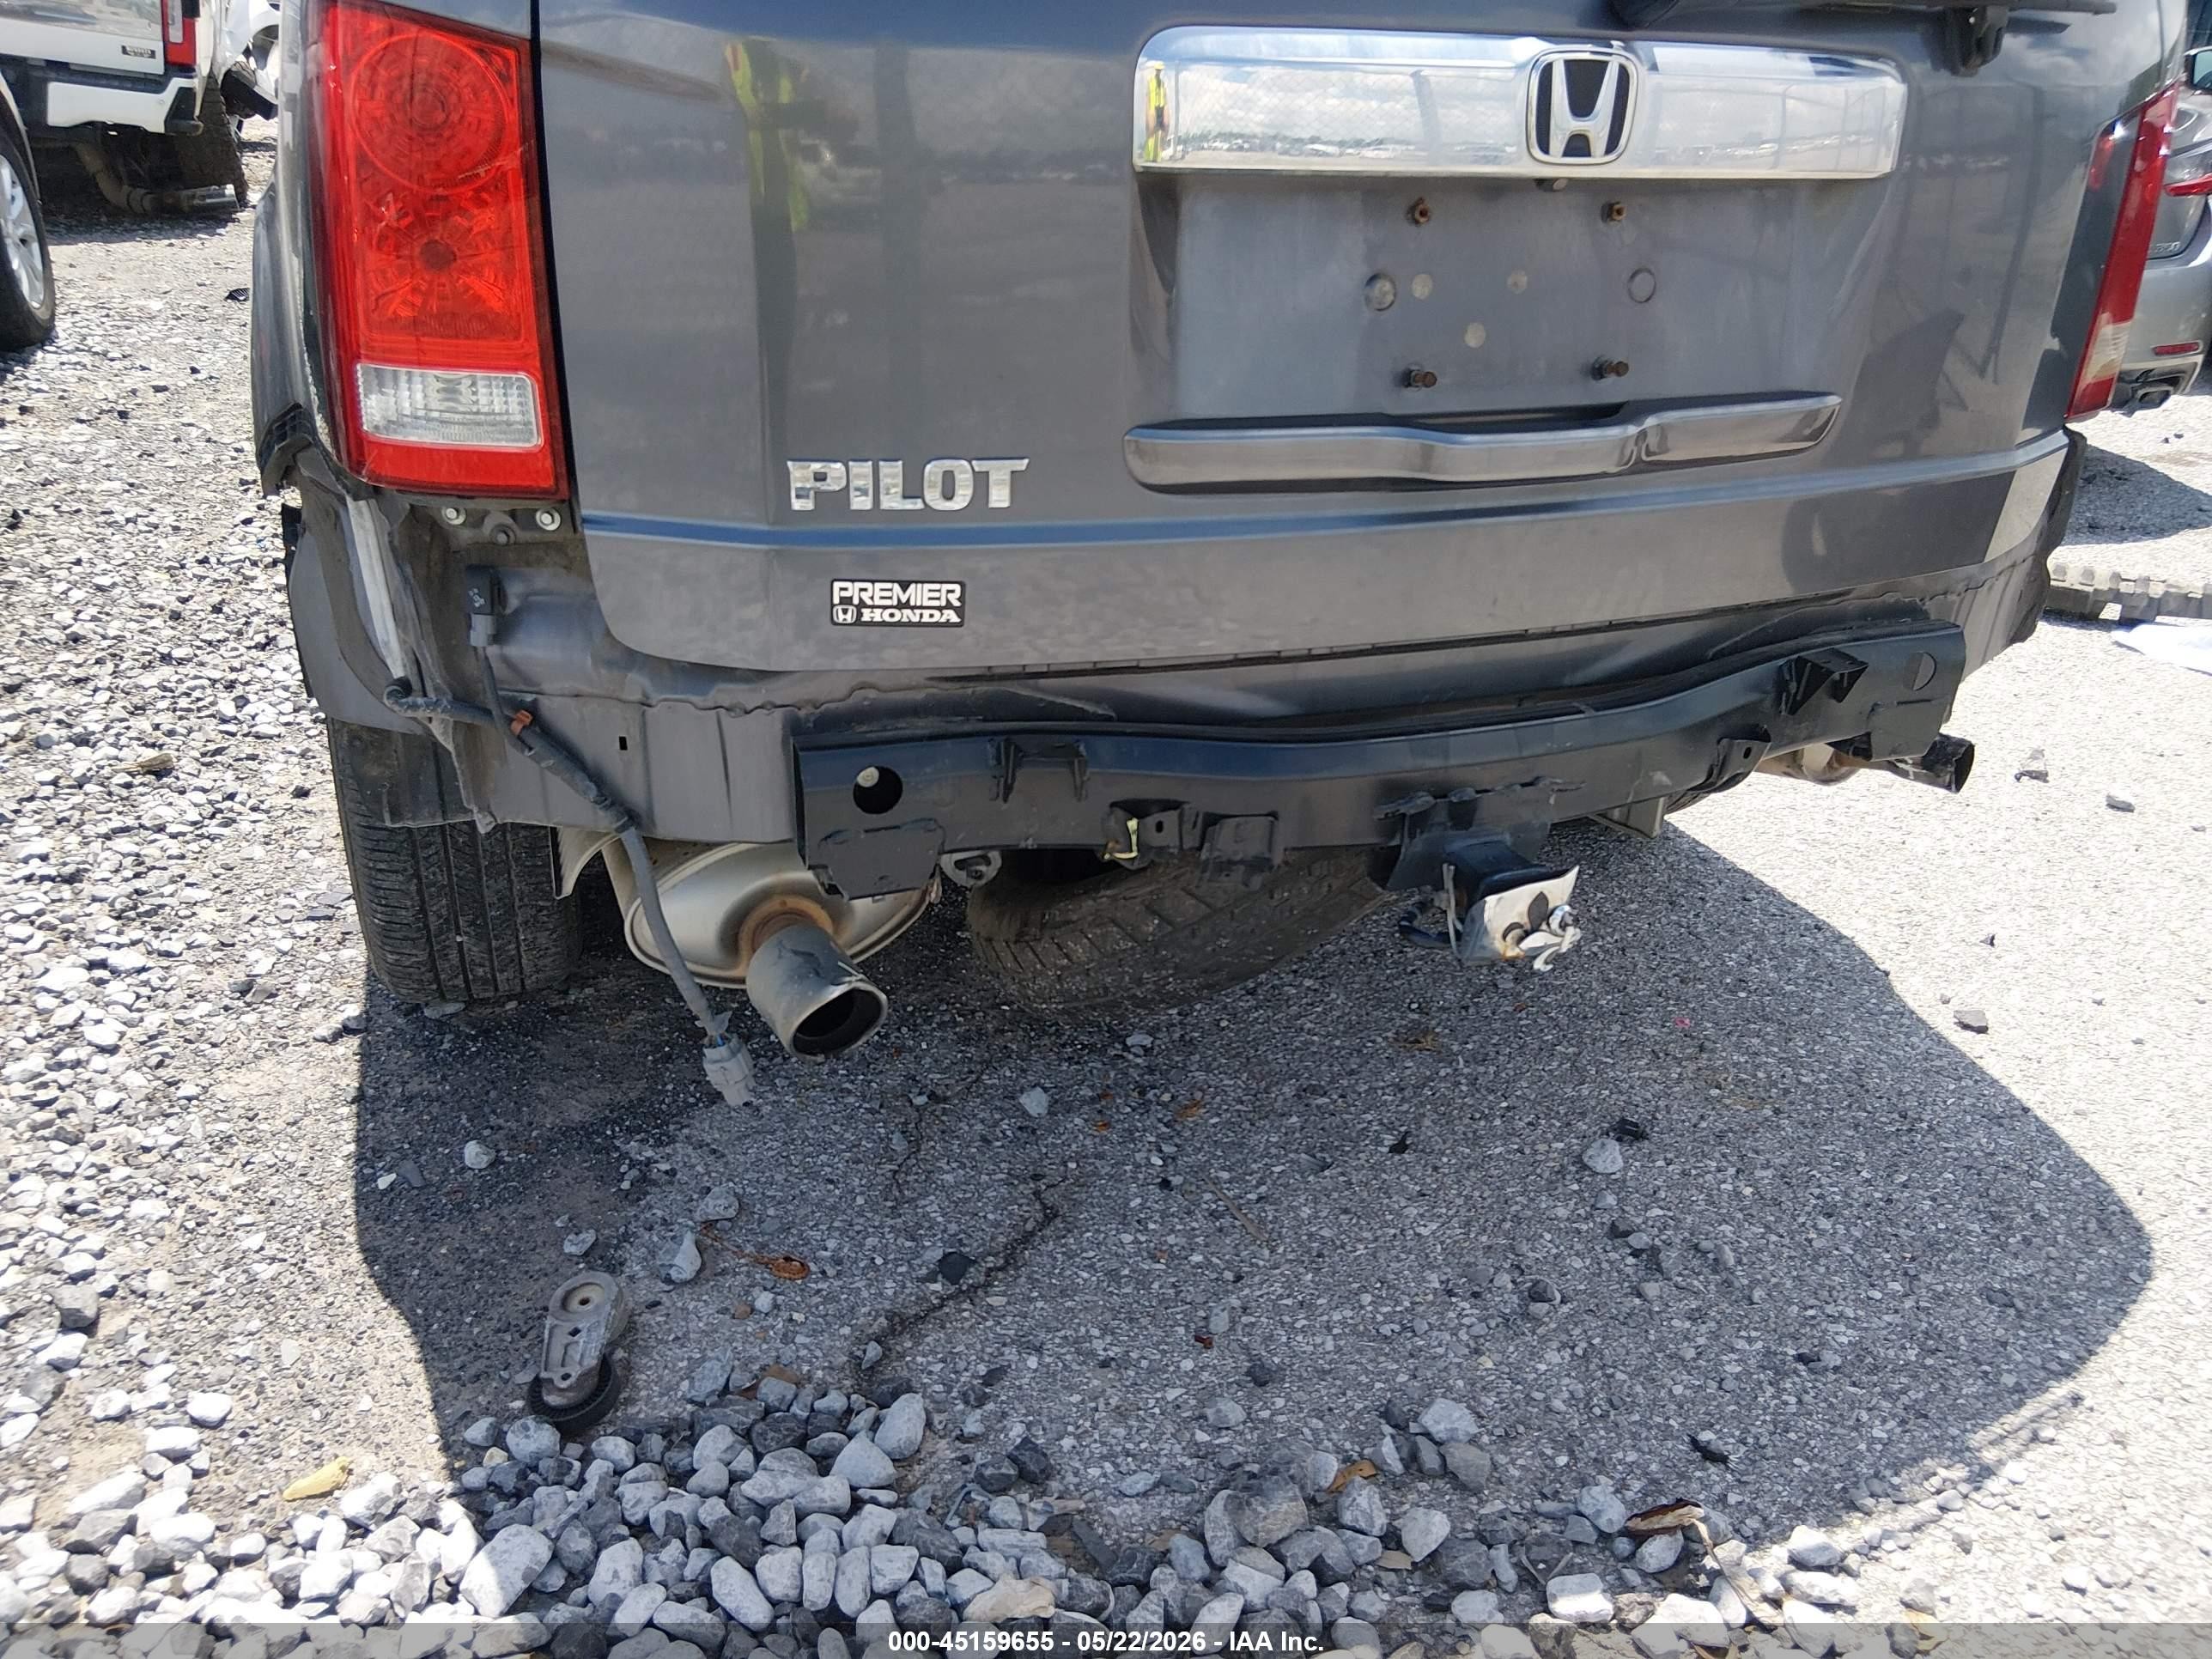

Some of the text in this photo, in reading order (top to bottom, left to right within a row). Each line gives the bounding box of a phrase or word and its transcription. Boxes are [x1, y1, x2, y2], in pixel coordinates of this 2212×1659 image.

[787, 458, 1030, 510] PILOT
[831, 580, 963, 607] PREMIER
[860, 607, 962, 623] HONDA
